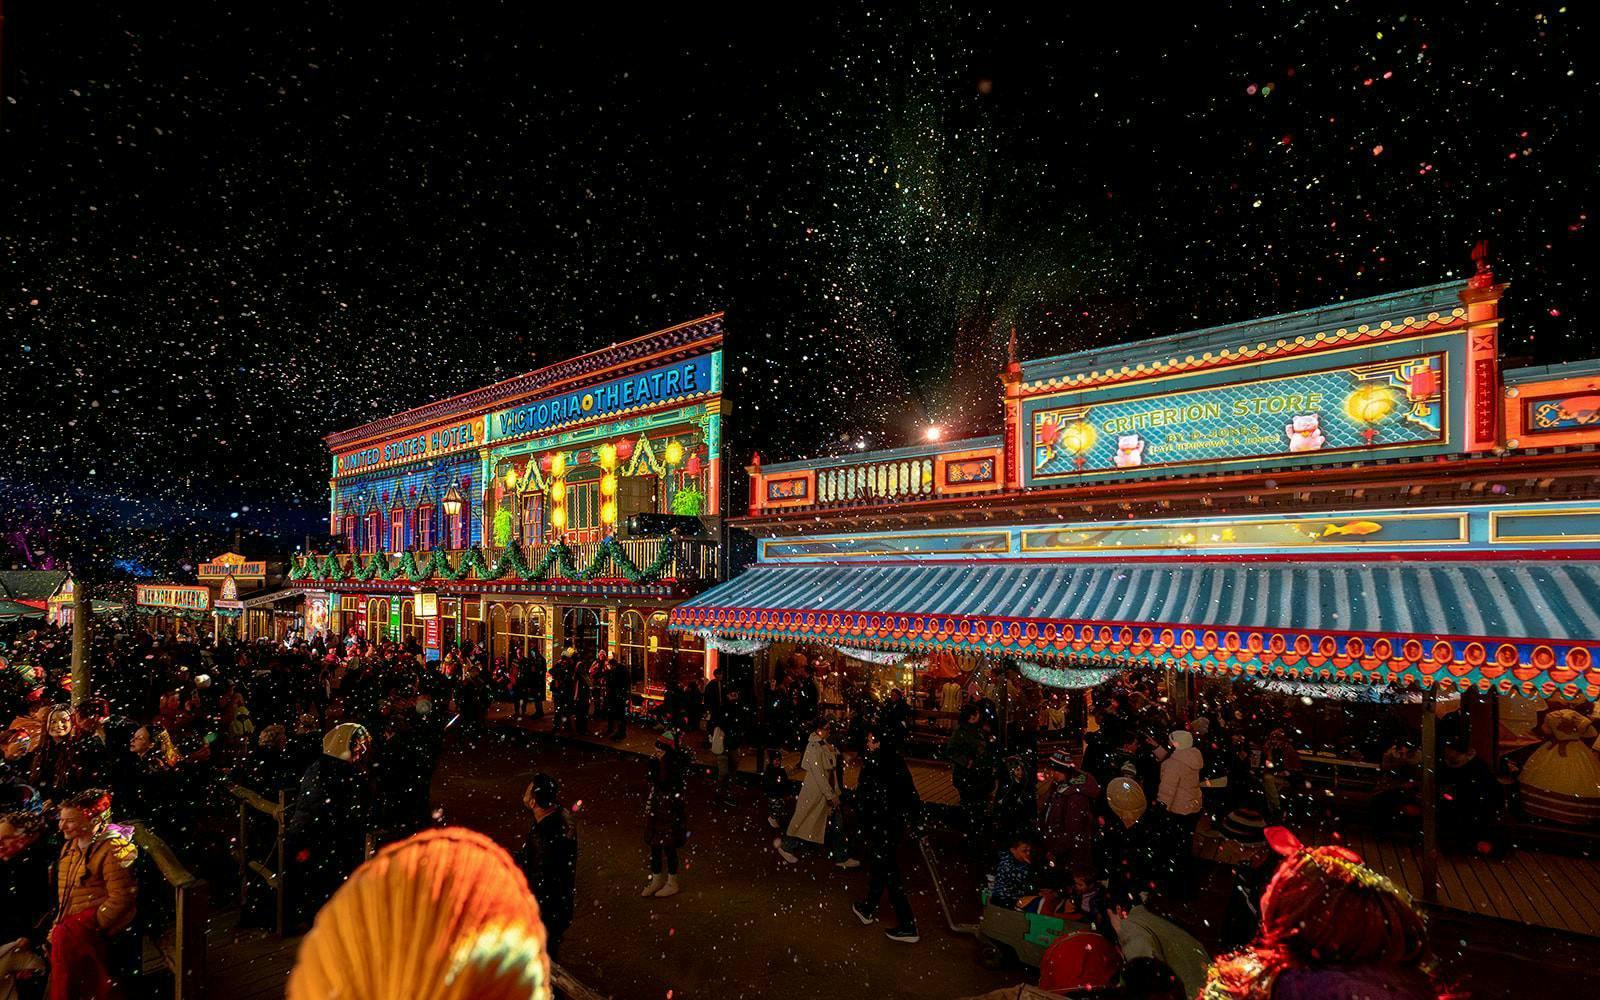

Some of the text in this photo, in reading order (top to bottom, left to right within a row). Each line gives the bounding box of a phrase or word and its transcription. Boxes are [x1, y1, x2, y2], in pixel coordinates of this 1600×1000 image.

[499, 364, 697, 434] VICTORIA THEATRE
[1102, 393, 1322, 434] CRITERION STORE
[1167, 433, 1184, 442] BY
[1176, 439, 1227, 451] HEMINGWAY
[343, 423, 475, 470] UNITED STATES HOTEL
[240, 564, 260, 575] ROOMS
[143, 589, 201, 606] NEW YORK BAKERY
